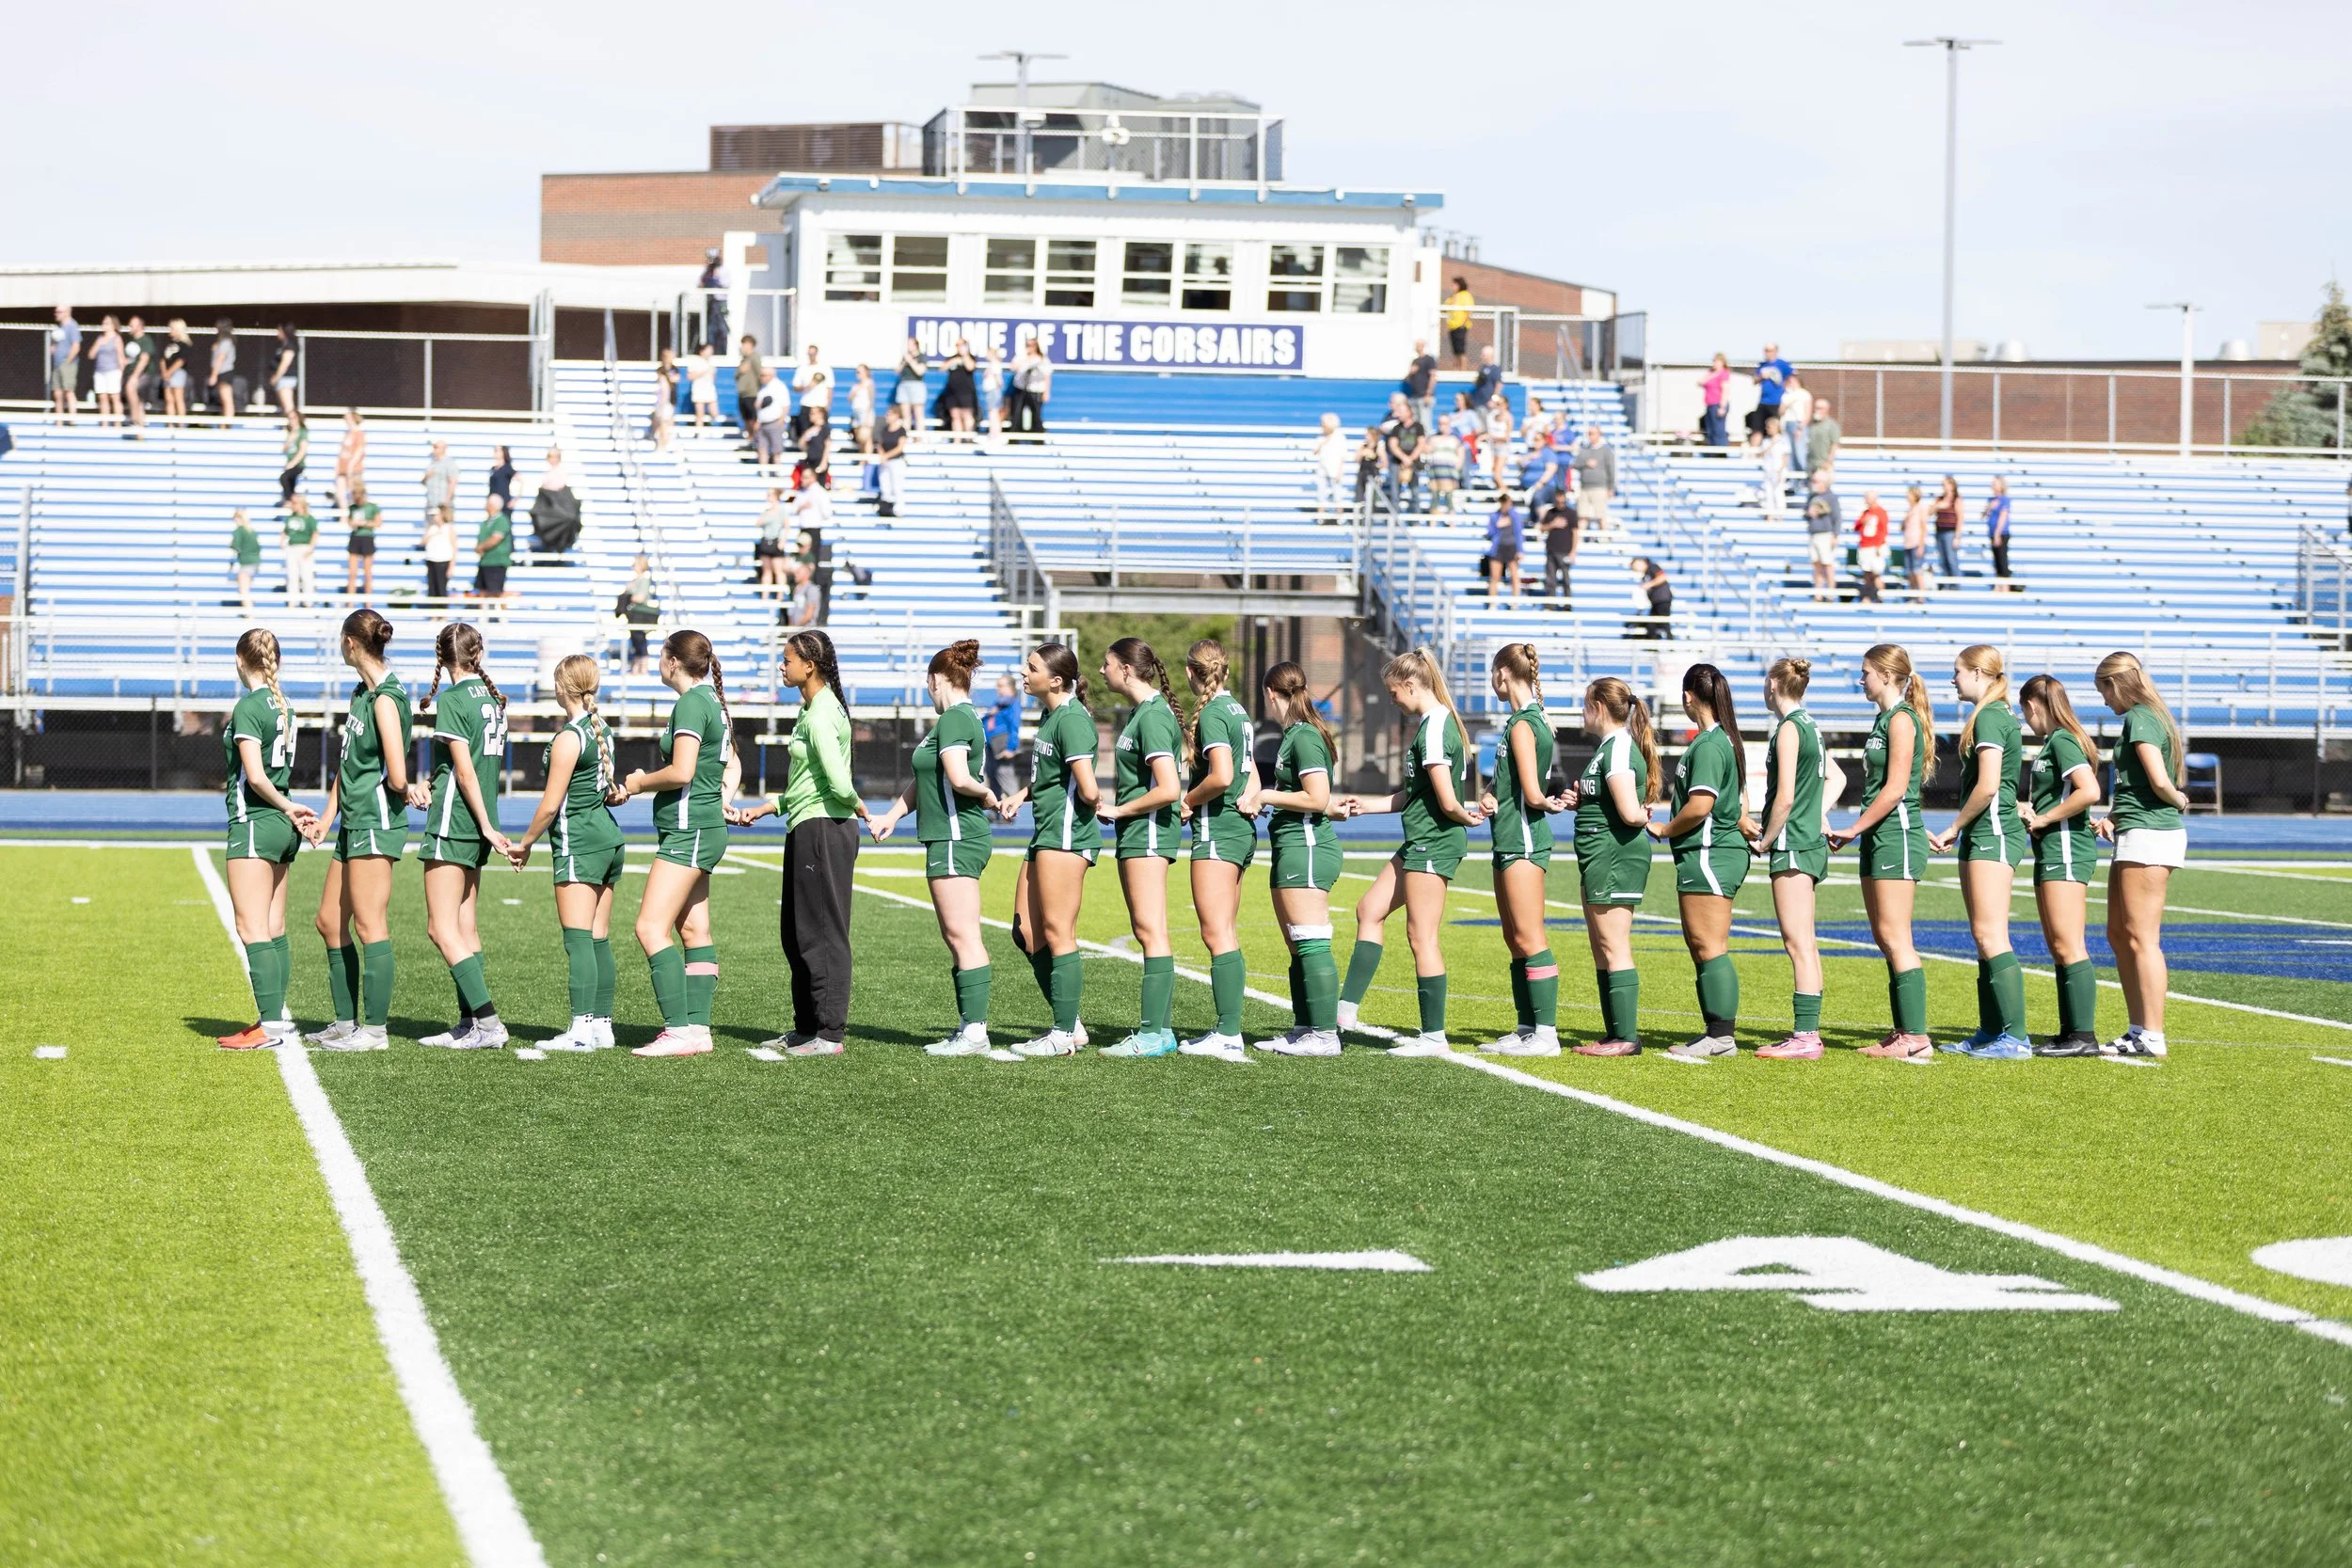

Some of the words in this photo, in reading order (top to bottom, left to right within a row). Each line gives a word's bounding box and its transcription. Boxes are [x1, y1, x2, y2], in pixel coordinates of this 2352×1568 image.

[915, 320, 1008, 358] HOME
[1015, 323, 1056, 358] OF
[1062, 324, 1123, 361] THE
[1130, 325, 1295, 365] CORSAIRS
[271, 715, 298, 768] 24
[481, 703, 508, 756] 22
